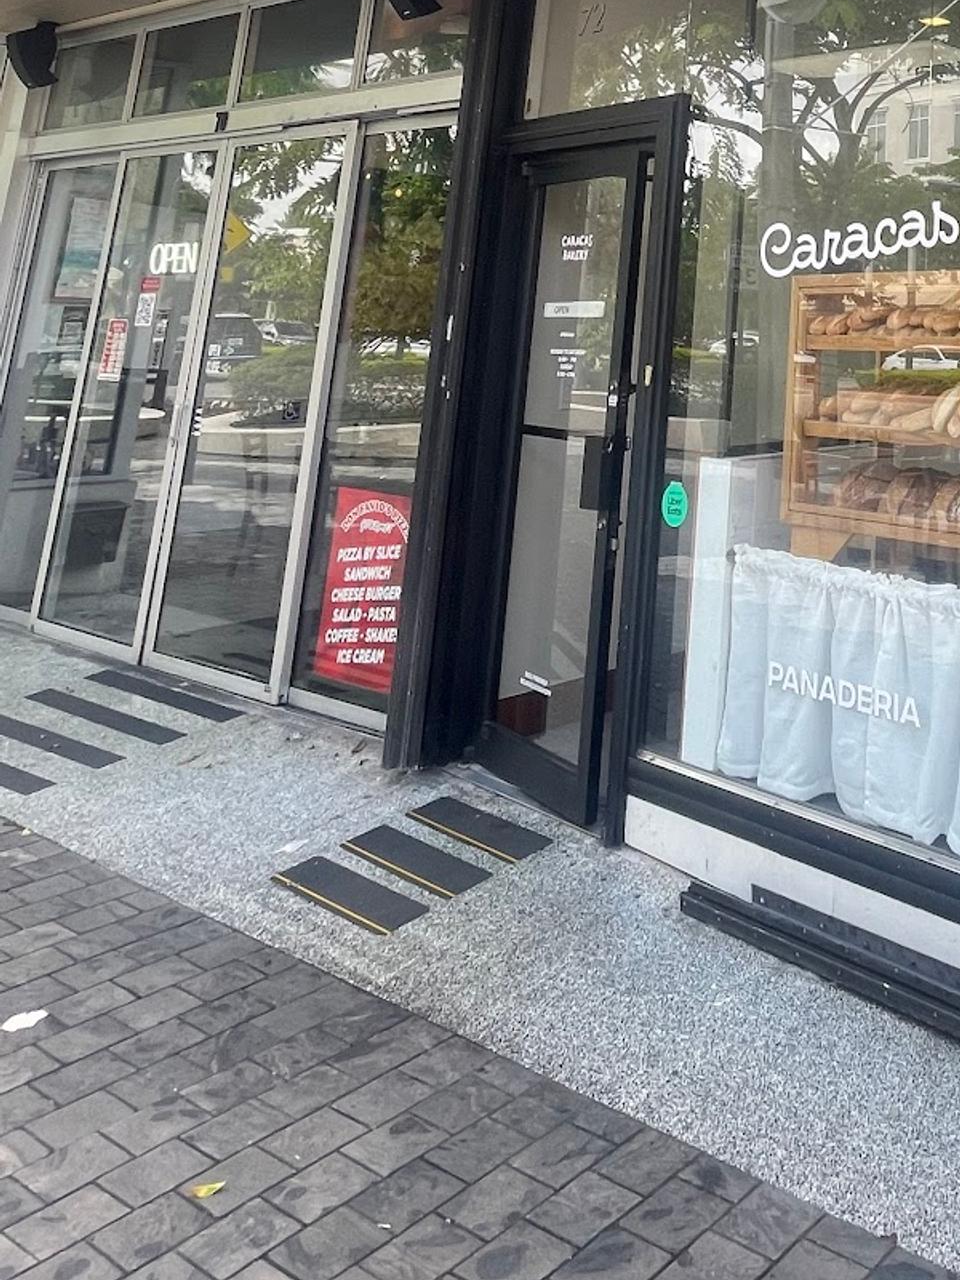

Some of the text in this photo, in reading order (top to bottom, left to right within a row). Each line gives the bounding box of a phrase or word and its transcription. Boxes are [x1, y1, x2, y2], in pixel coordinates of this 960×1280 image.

[578, 3, 607, 37] 72
[561, 233, 594, 248] CARACAS
[759, 199, 960, 279] Caracas
[149, 241, 199, 275] OPEN
[563, 249, 589, 261] BAKERY
[337, 544, 402, 562] PIZZA BY SLICE
[343, 566, 392, 581] SANDWICH
[331, 585, 402, 602] CHEESE BURGER
[331, 606, 397, 622] SALAD PASTA
[325, 627, 360, 643] COFFEE
[336, 648, 386, 664] ICE CREAM
[767, 660, 921, 728] PANADERIA
